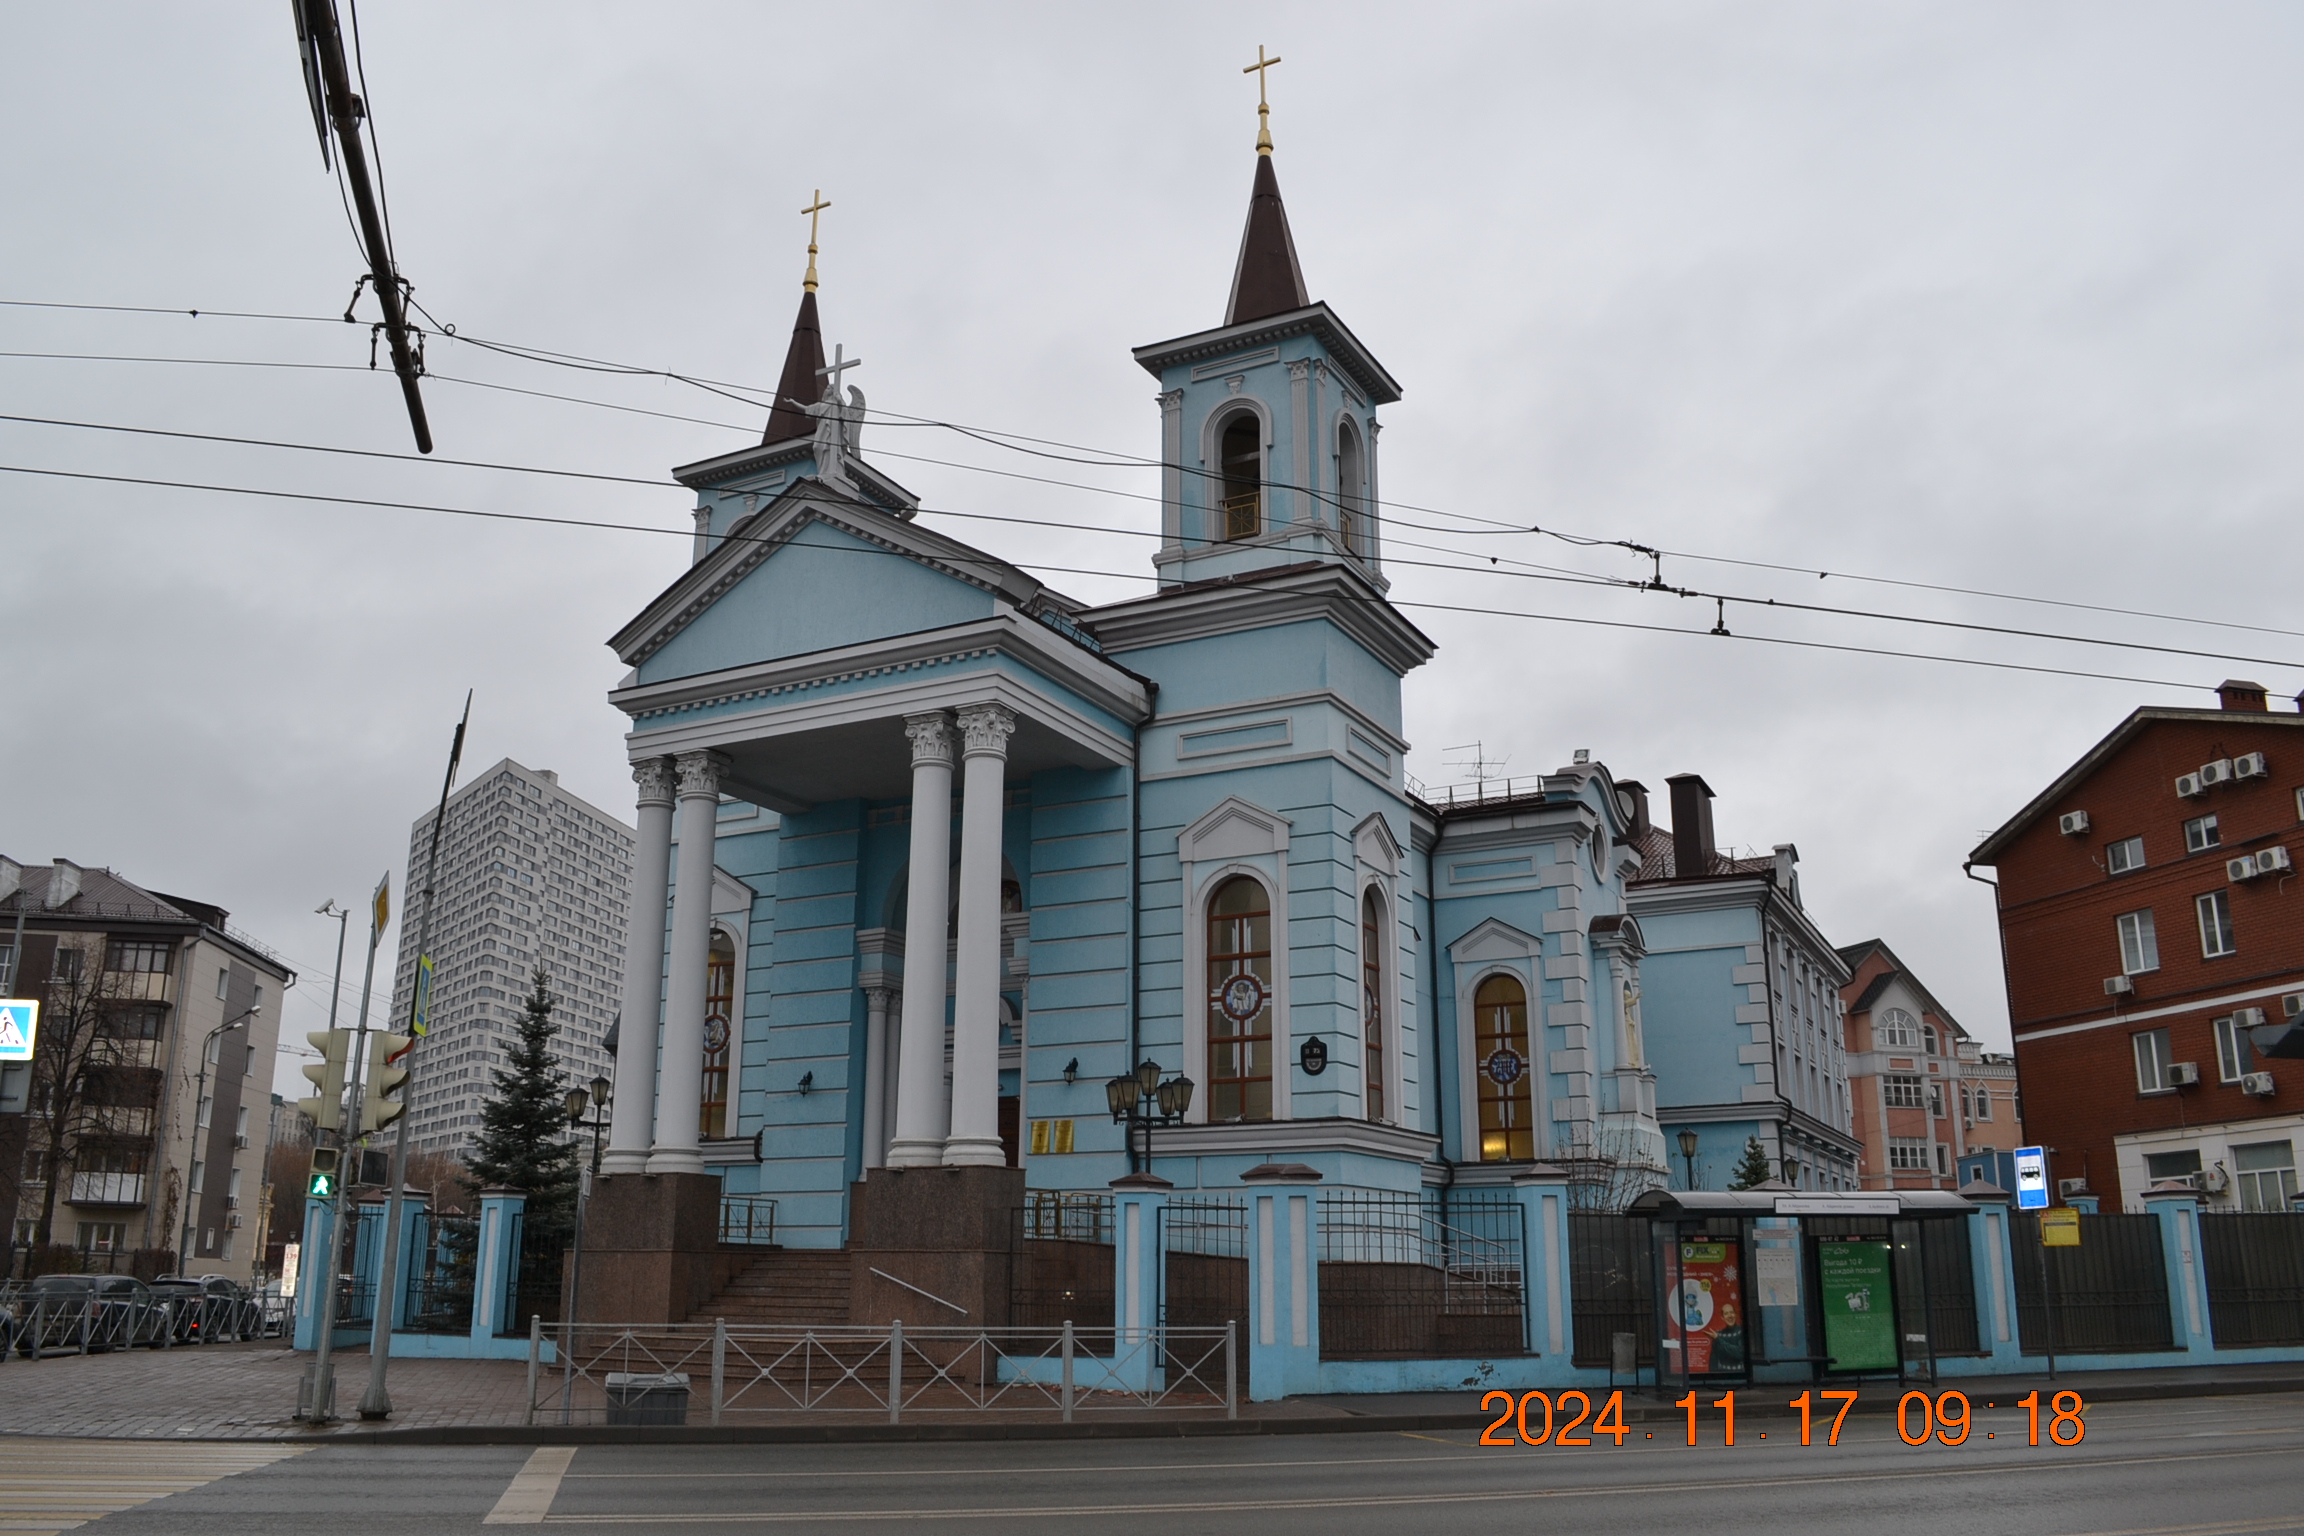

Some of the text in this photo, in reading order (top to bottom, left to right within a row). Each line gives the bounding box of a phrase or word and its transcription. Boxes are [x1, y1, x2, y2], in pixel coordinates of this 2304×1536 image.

[1823, 1259, 1848, 1267] Выгода
[1849, 1258, 1857, 1266] 10
[1829, 1266, 1855, 1275] каждой
[1855, 1267, 1882, 1275] поездки
